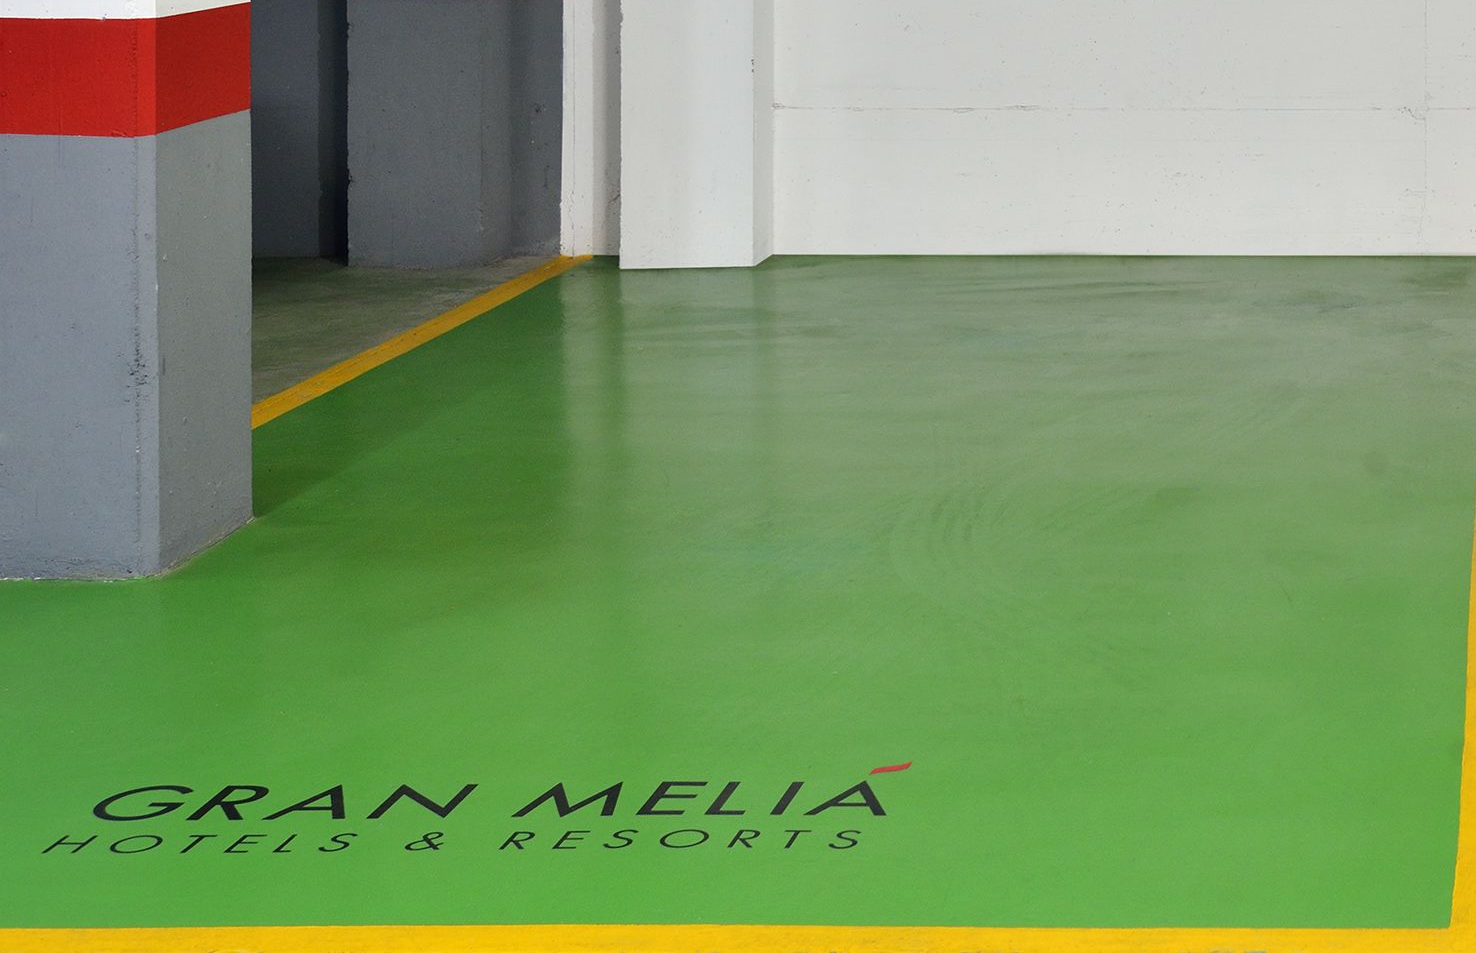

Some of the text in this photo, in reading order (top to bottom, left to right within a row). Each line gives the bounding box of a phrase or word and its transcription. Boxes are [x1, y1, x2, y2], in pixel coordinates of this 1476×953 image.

[93, 762, 912, 821] GRAN MELIÁ
[41, 828, 865, 855] HOTELS & RESORTS
